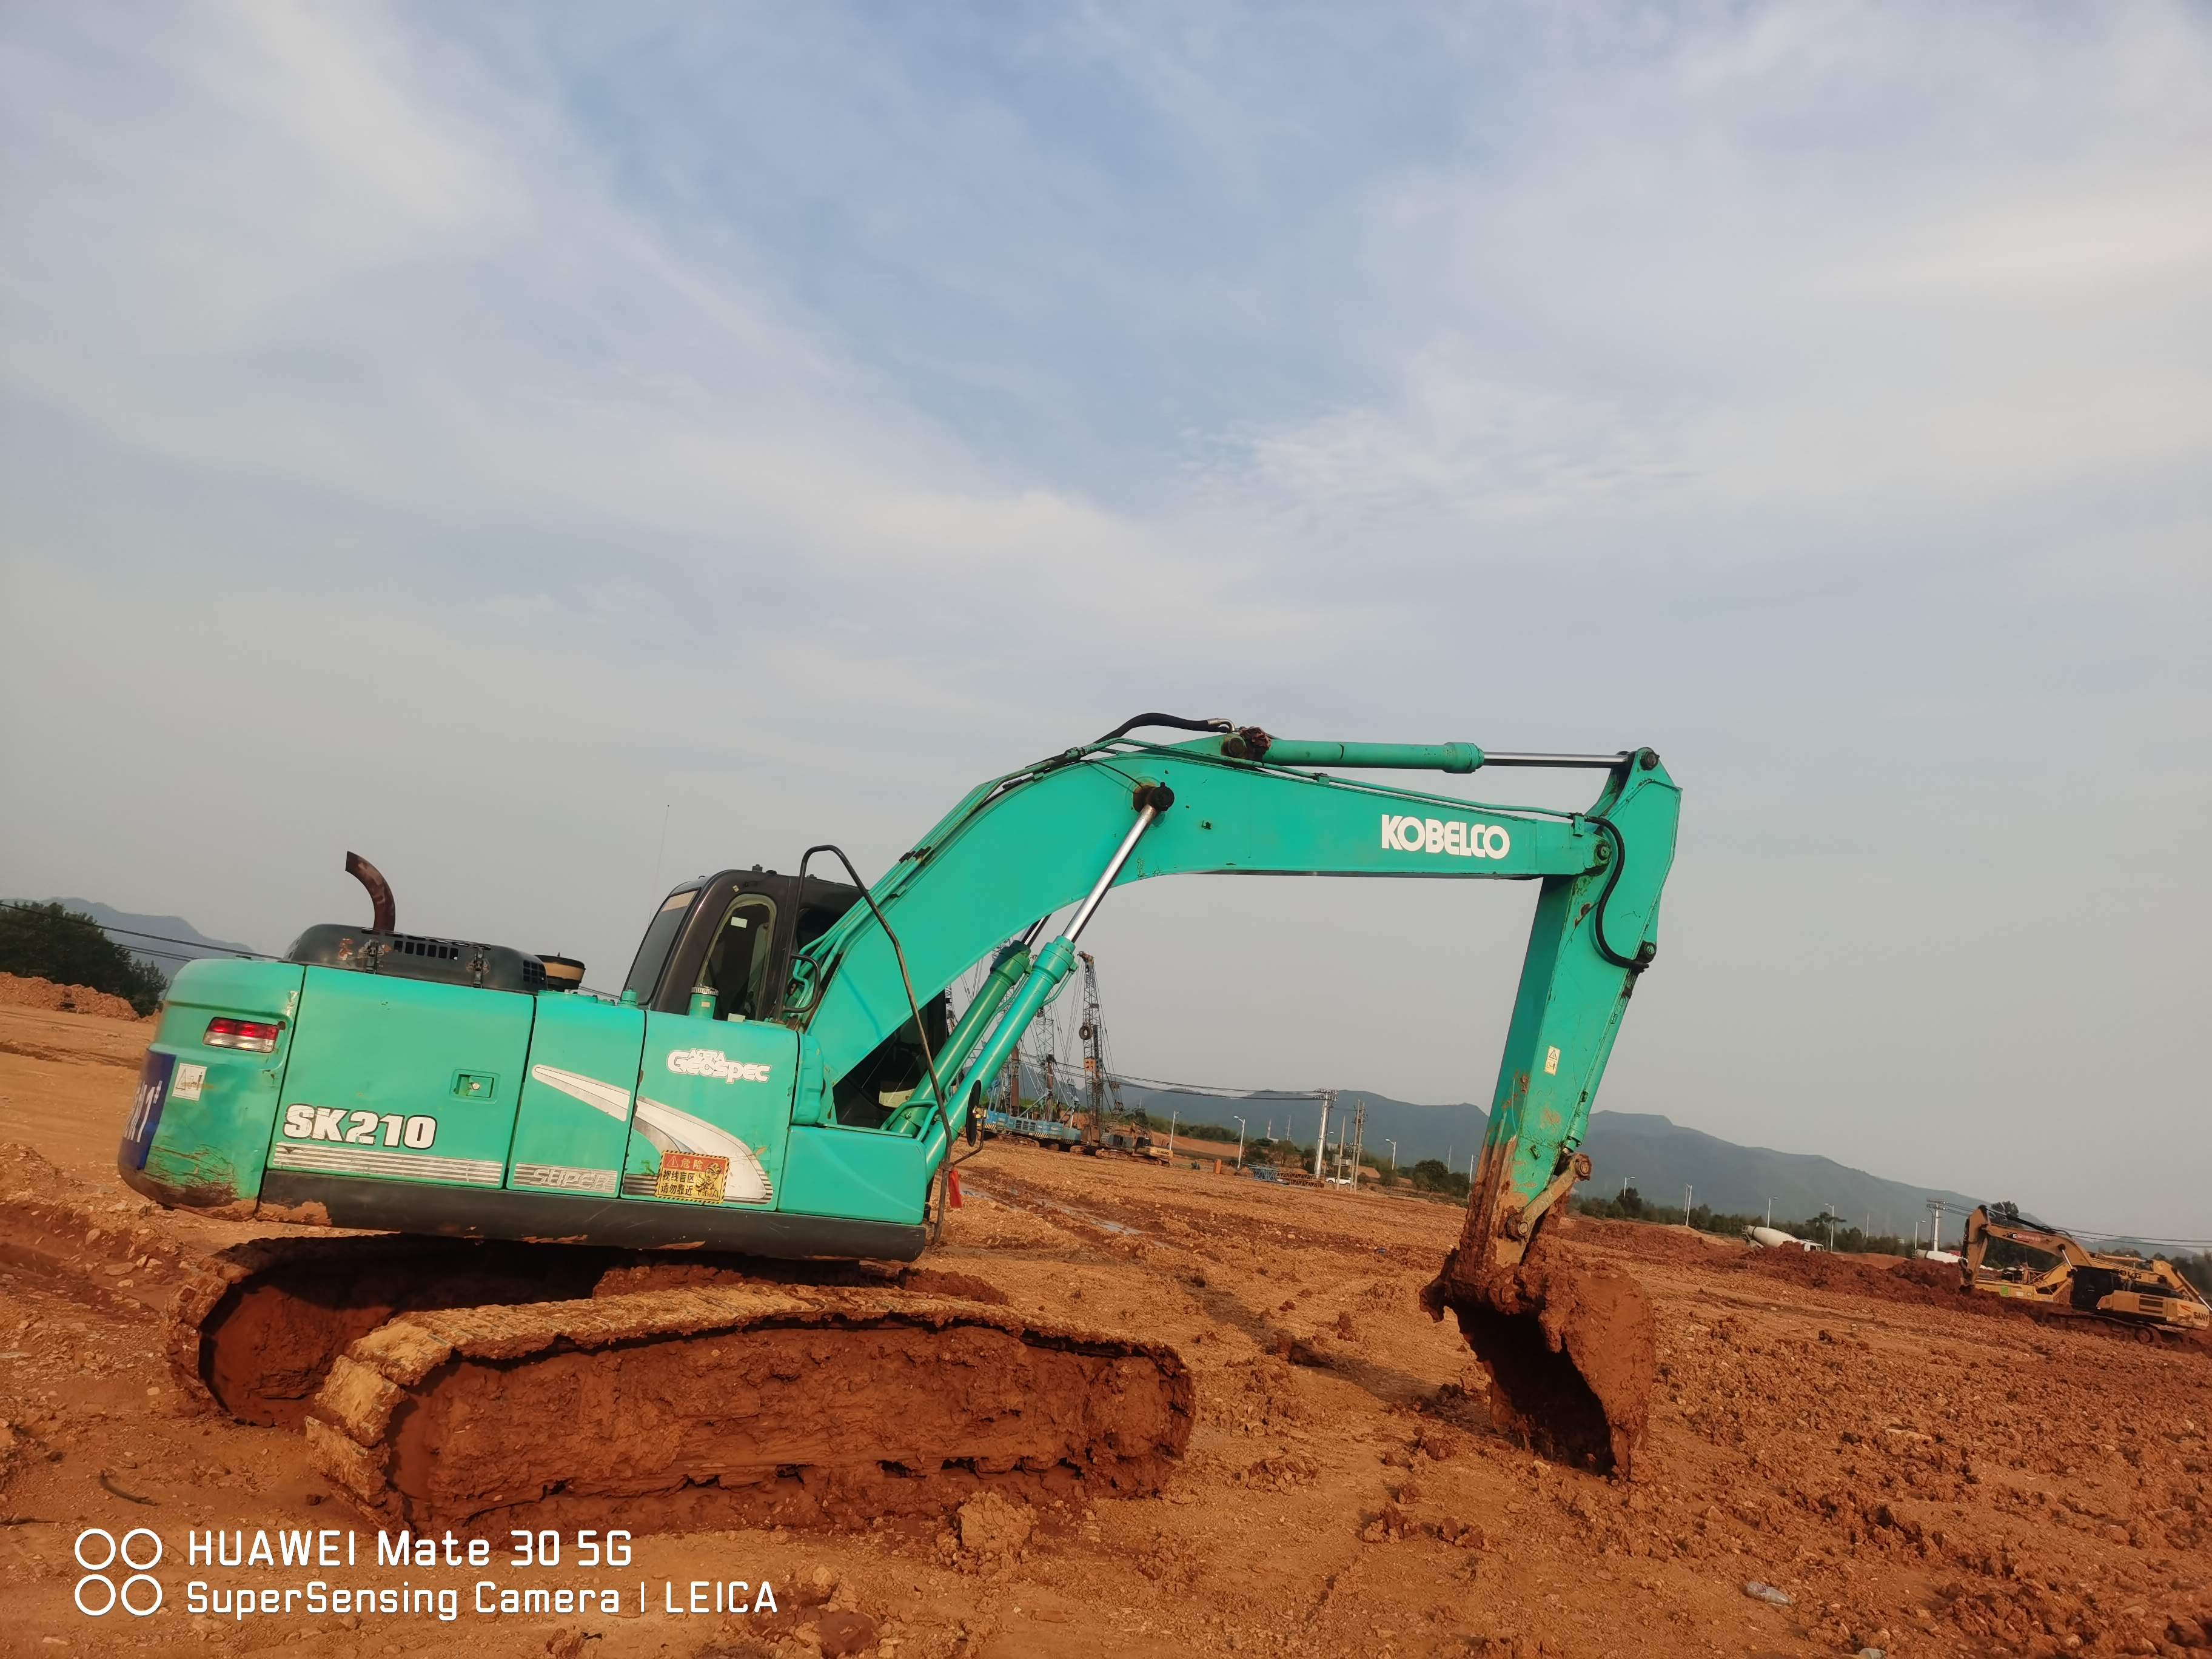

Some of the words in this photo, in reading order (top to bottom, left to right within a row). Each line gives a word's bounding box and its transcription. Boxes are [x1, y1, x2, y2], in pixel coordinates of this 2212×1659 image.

[1381, 814, 1510, 860] KOBELCO
[283, 1103, 438, 1150] SK210
[680, 1158, 703, 1170] 危险
[663, 1170, 695, 1184] 视线盲区
[660, 1182, 694, 1196] 请勿靠近
[2193, 1311, 2209, 1322] SANY
